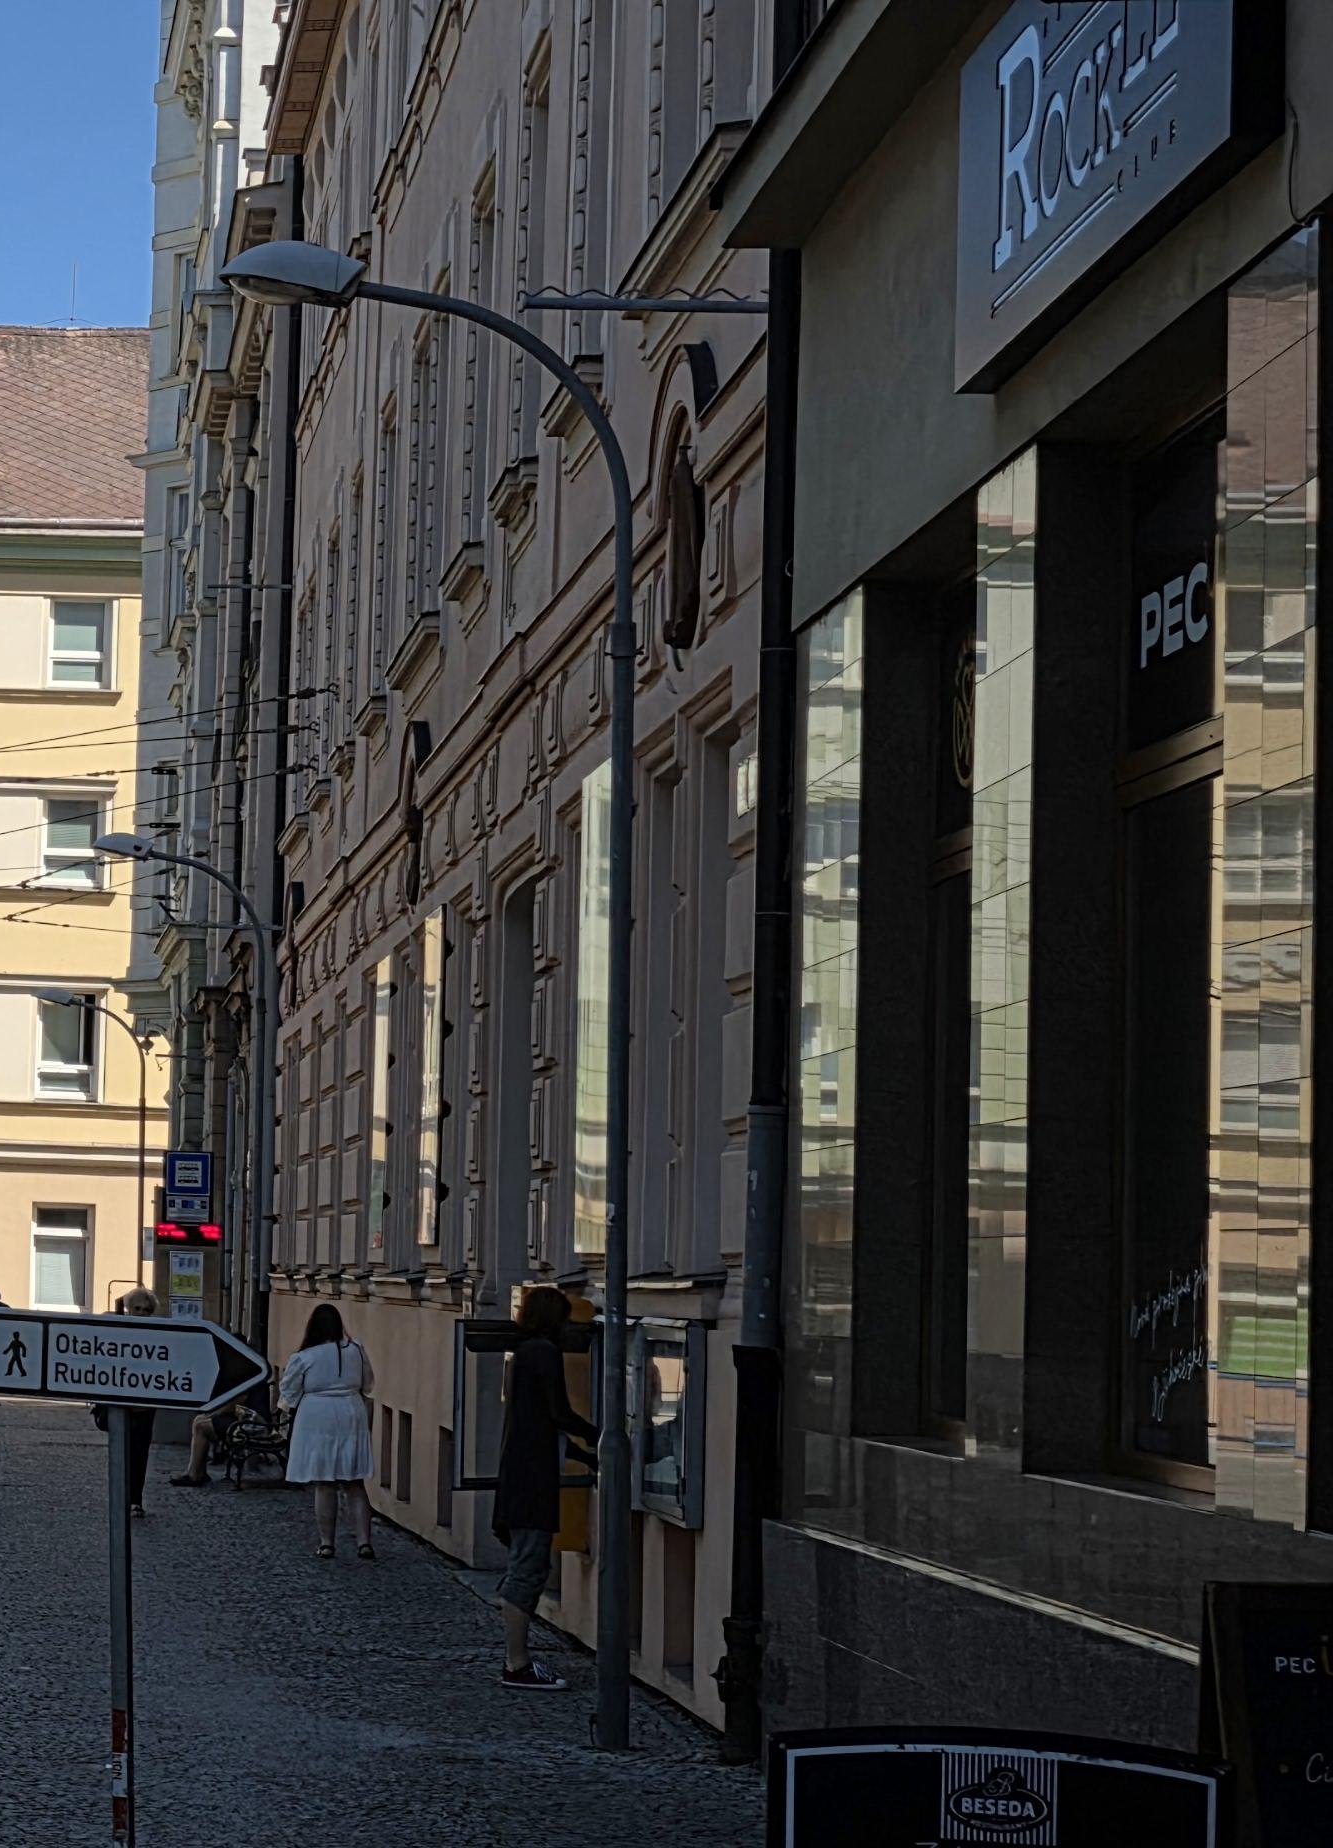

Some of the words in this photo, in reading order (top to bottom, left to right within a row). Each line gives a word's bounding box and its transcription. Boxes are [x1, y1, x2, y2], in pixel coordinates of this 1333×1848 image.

[1140, 561, 1209, 670] PEC
[55, 1333, 169, 1361] Otakarova
[54, 1362, 193, 1392] Rudolfovská
[1274, 1655, 1317, 1674] PEC
[961, 1796, 1036, 1818] BESEDA
